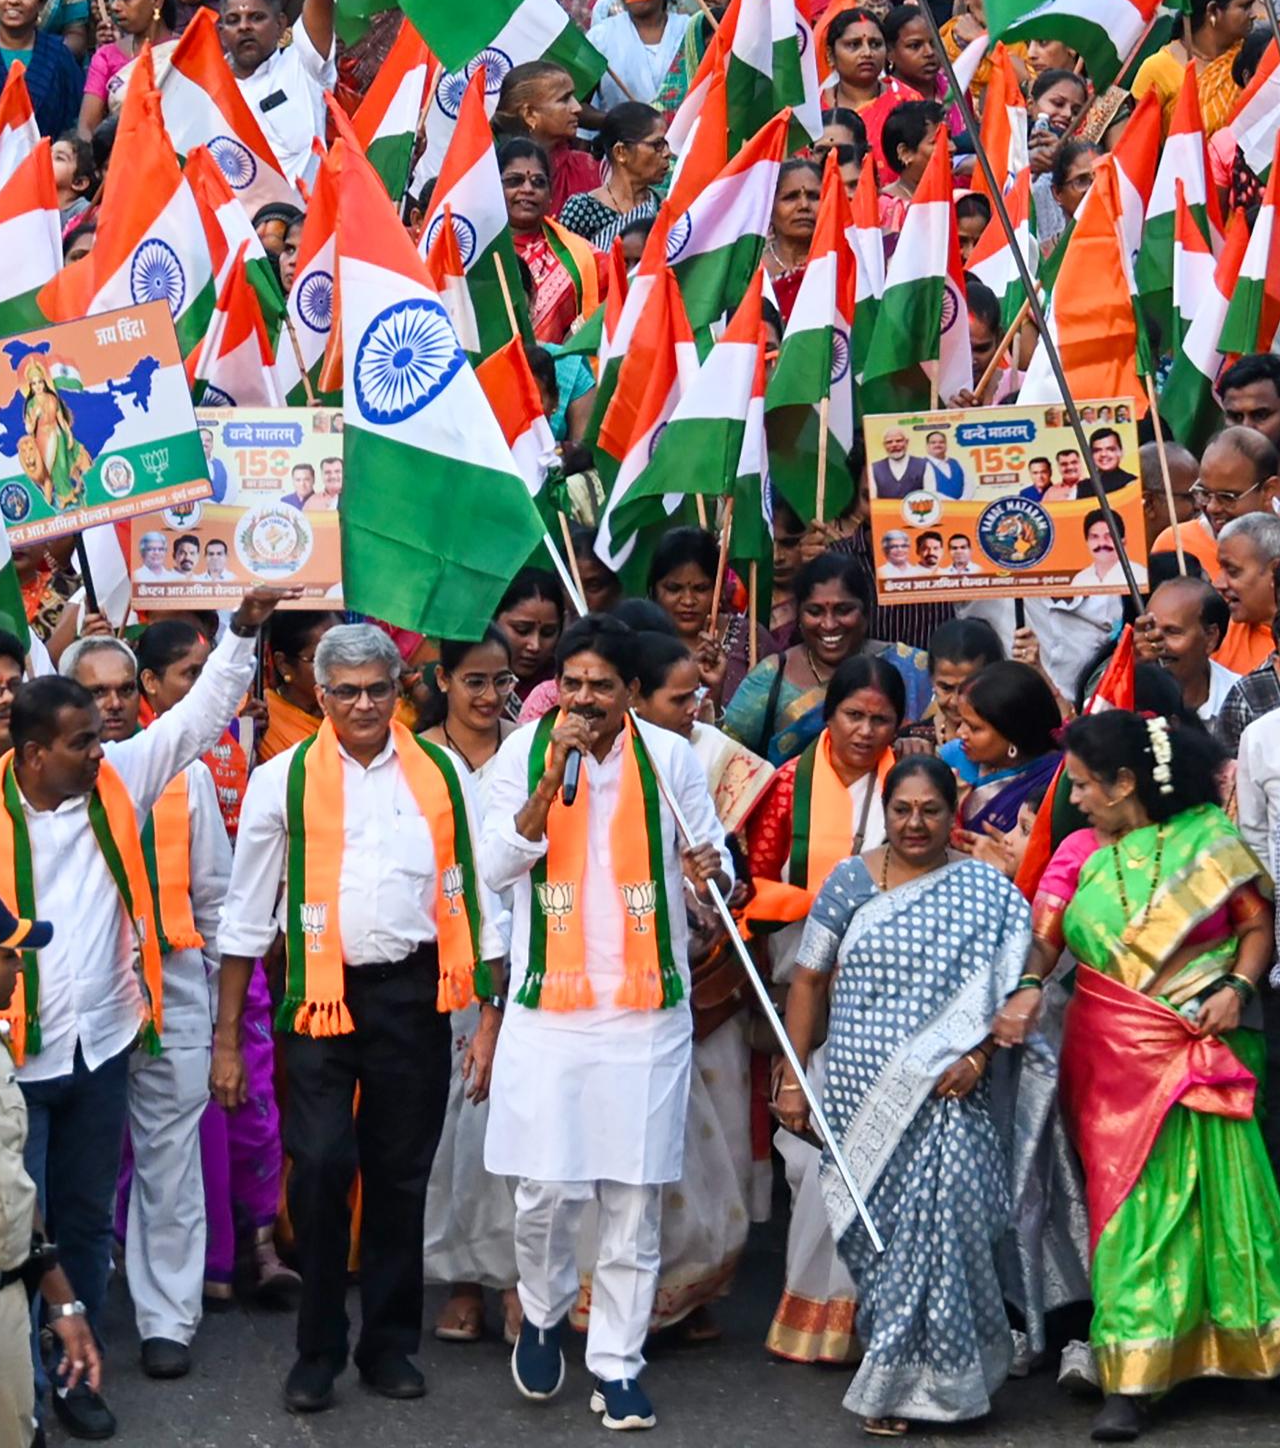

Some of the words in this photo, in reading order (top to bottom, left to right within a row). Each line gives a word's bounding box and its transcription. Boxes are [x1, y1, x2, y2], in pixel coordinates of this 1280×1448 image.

[94, 327, 116, 347] जय
[117, 316, 147, 343] हिंद!
[228, 423, 253, 441] वन्दे
[255, 427, 296, 445] मातरम्
[962, 425, 986, 441] वन्दे
[987, 424, 1030, 441] मातरम्
[234, 449, 290, 477] 150
[969, 445, 1026, 474] 150
[981, 504, 1005, 532] VANDE
[1006, 500, 1048, 530] MATARAM
